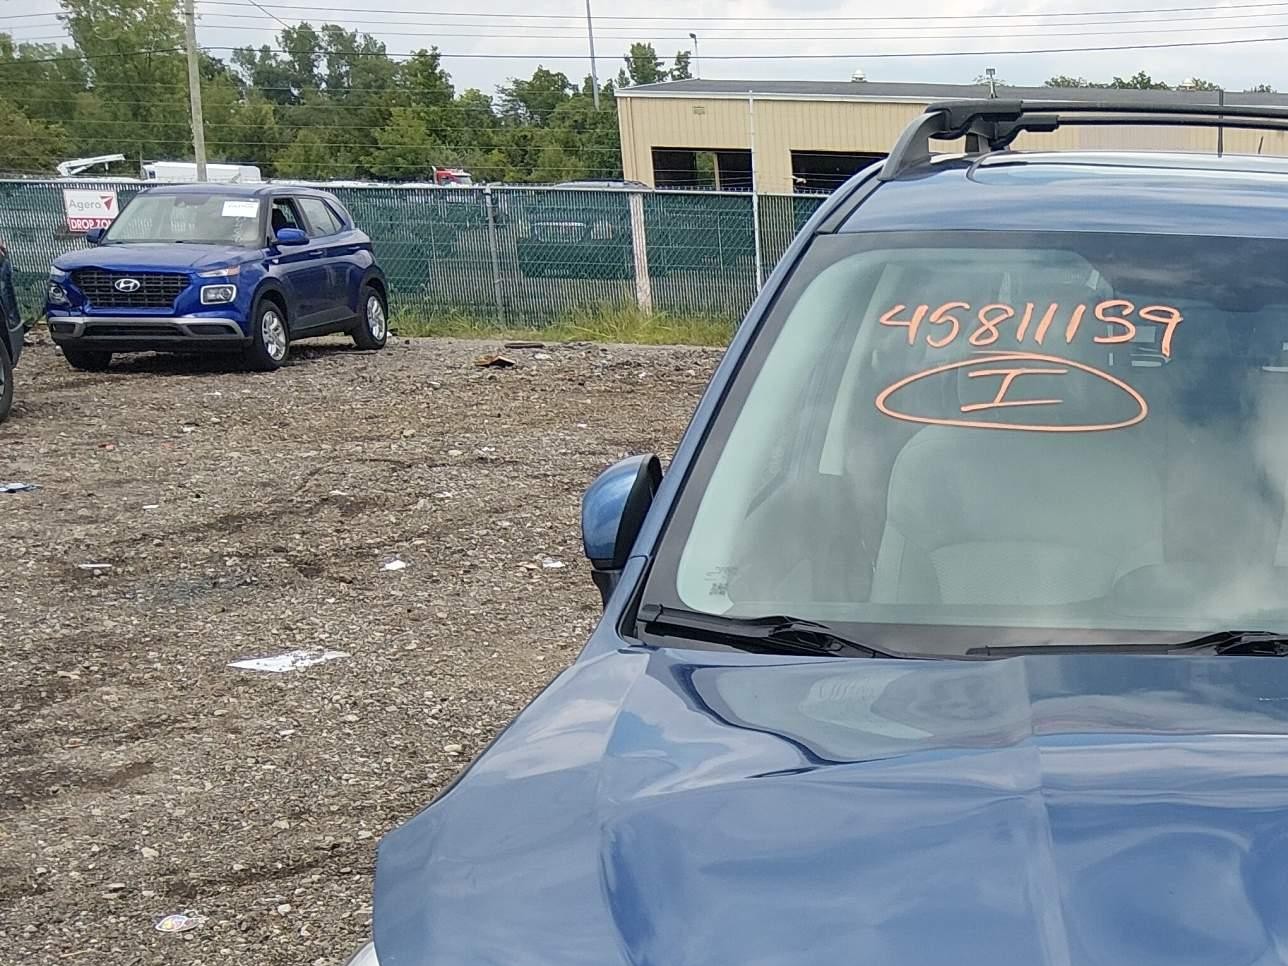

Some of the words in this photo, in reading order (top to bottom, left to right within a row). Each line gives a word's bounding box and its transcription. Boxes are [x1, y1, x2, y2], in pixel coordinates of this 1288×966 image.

[69, 200, 101, 211] Agero
[71, 219, 95, 229] DROP
[880, 300, 1184, 359] 45811159
